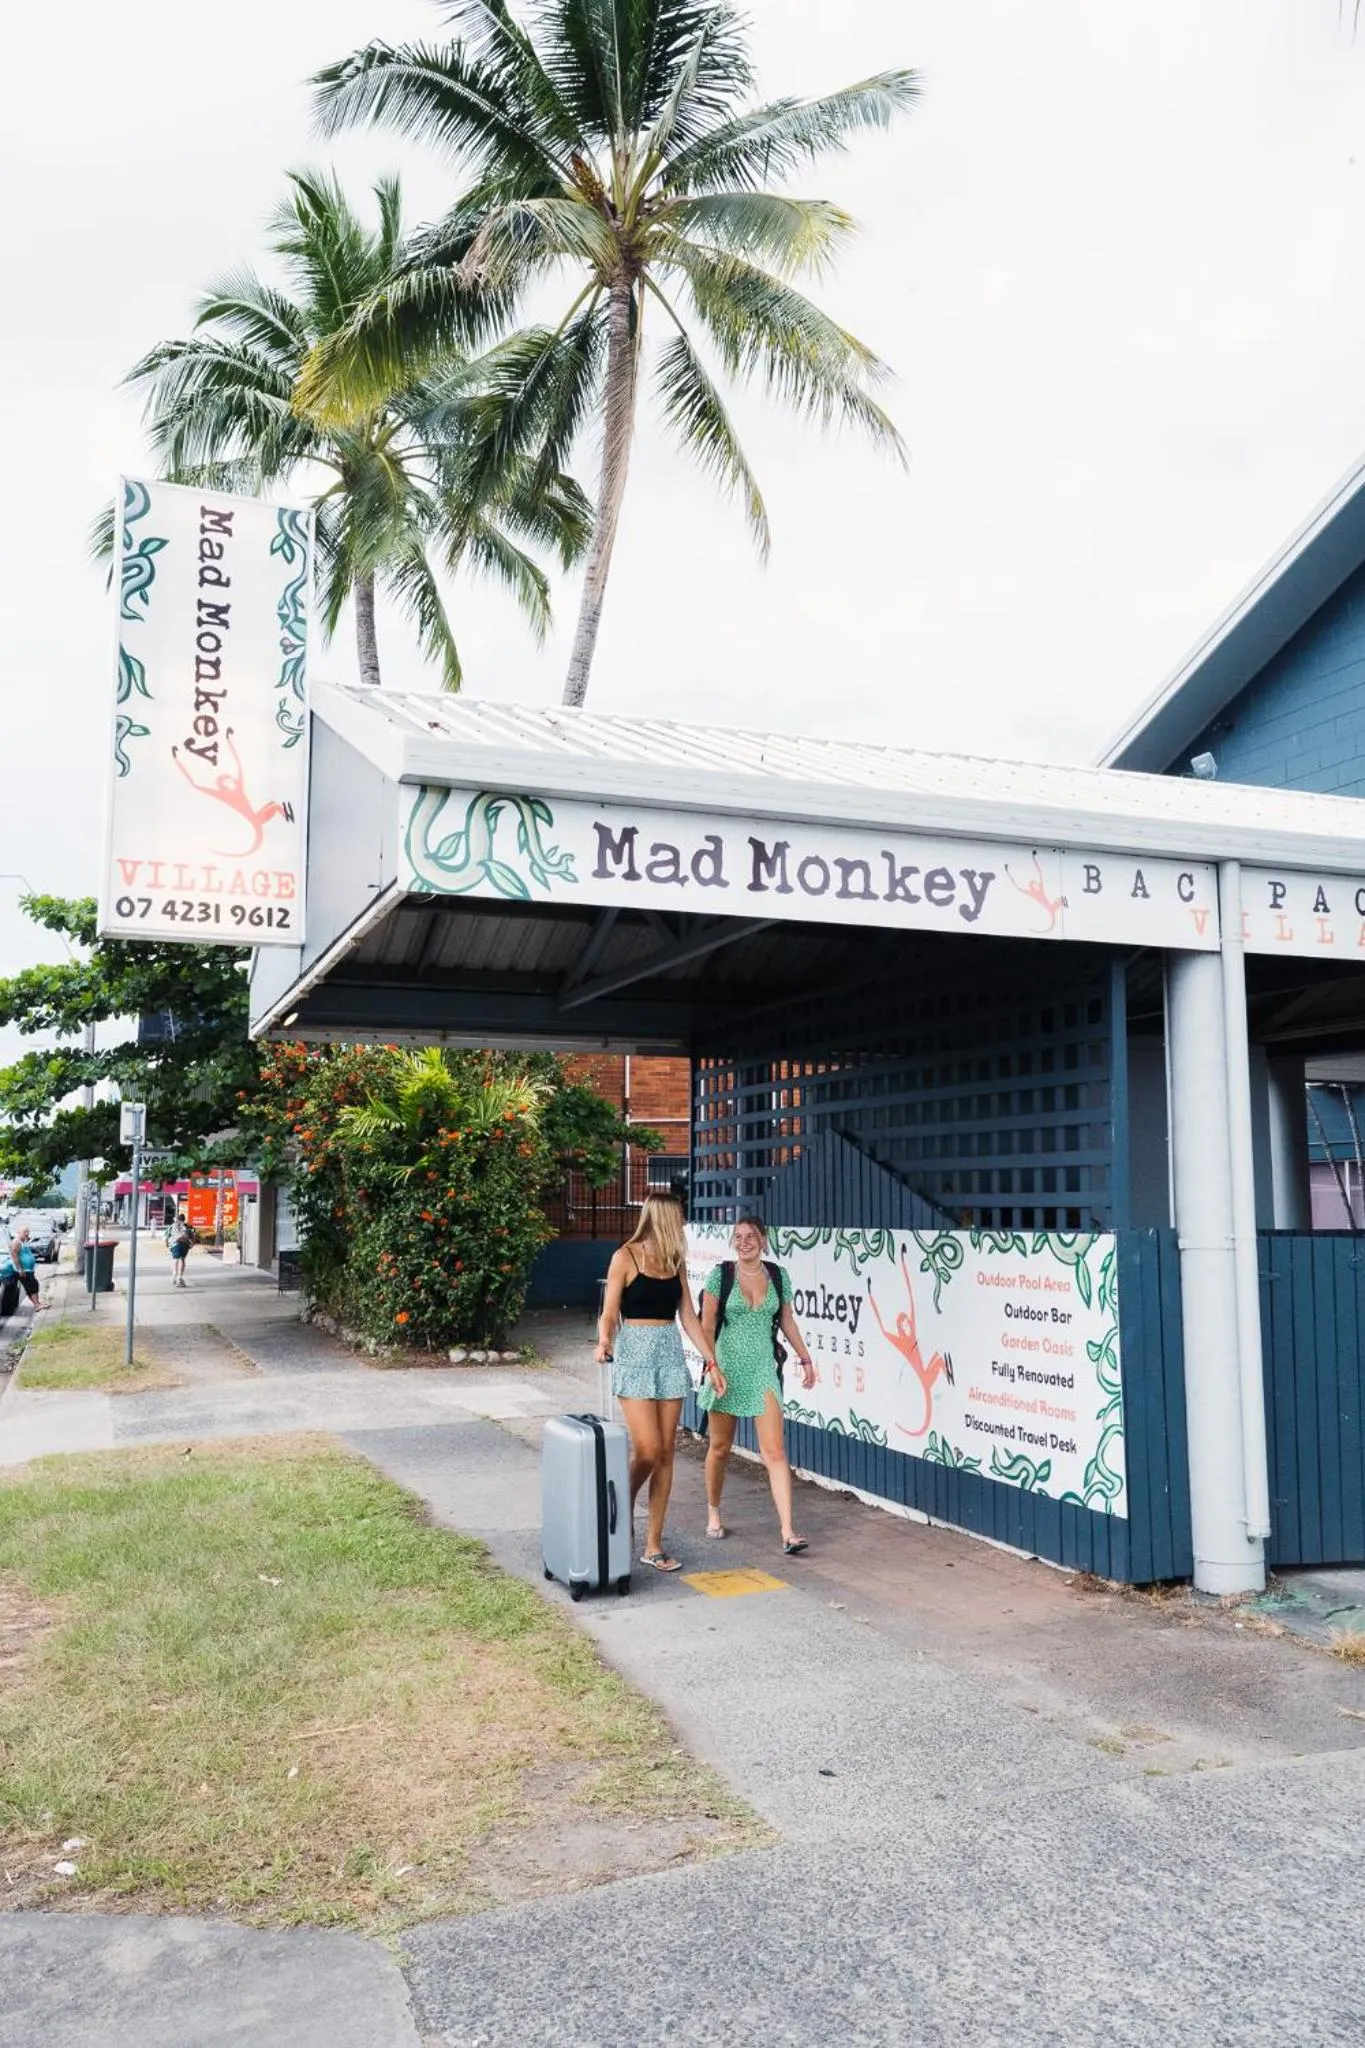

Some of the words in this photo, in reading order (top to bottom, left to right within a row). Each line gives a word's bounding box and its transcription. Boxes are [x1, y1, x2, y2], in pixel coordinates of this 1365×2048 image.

[197, 505, 234, 588] Mad
[185, 598, 230, 766] Monkey
[116, 858, 296, 898] VILLAGE
[592, 822, 730, 888] Mad
[747, 836, 996, 923] Monkey
[116, 896, 153, 919] 07
[161, 900, 221, 924] 4231
[230, 905, 291, 929] 9612
[977, 1272, 1017, 1289] Outdoor
[1019, 1275, 1042, 1291] Pool
[1044, 1277, 1071, 1293] Area
[794, 1283, 863, 1334] onkey
[1004, 1302, 1049, 1322] Outdoor
[1051, 1308, 1073, 1324] Bar
[1001, 1332, 1040, 1351] Garden
[1042, 1338, 1075, 1356] Oasis
[991, 1361, 1016, 1383] Fully
[1017, 1365, 1074, 1389] Renovated
[968, 1386, 1039, 1414] Airconditioned
[1039, 1401, 1077, 1421] Rooms
[964, 1414, 1016, 1439] Discounted
[1017, 1427, 1048, 1447] Travel
[1049, 1434, 1078, 1455] Desk
